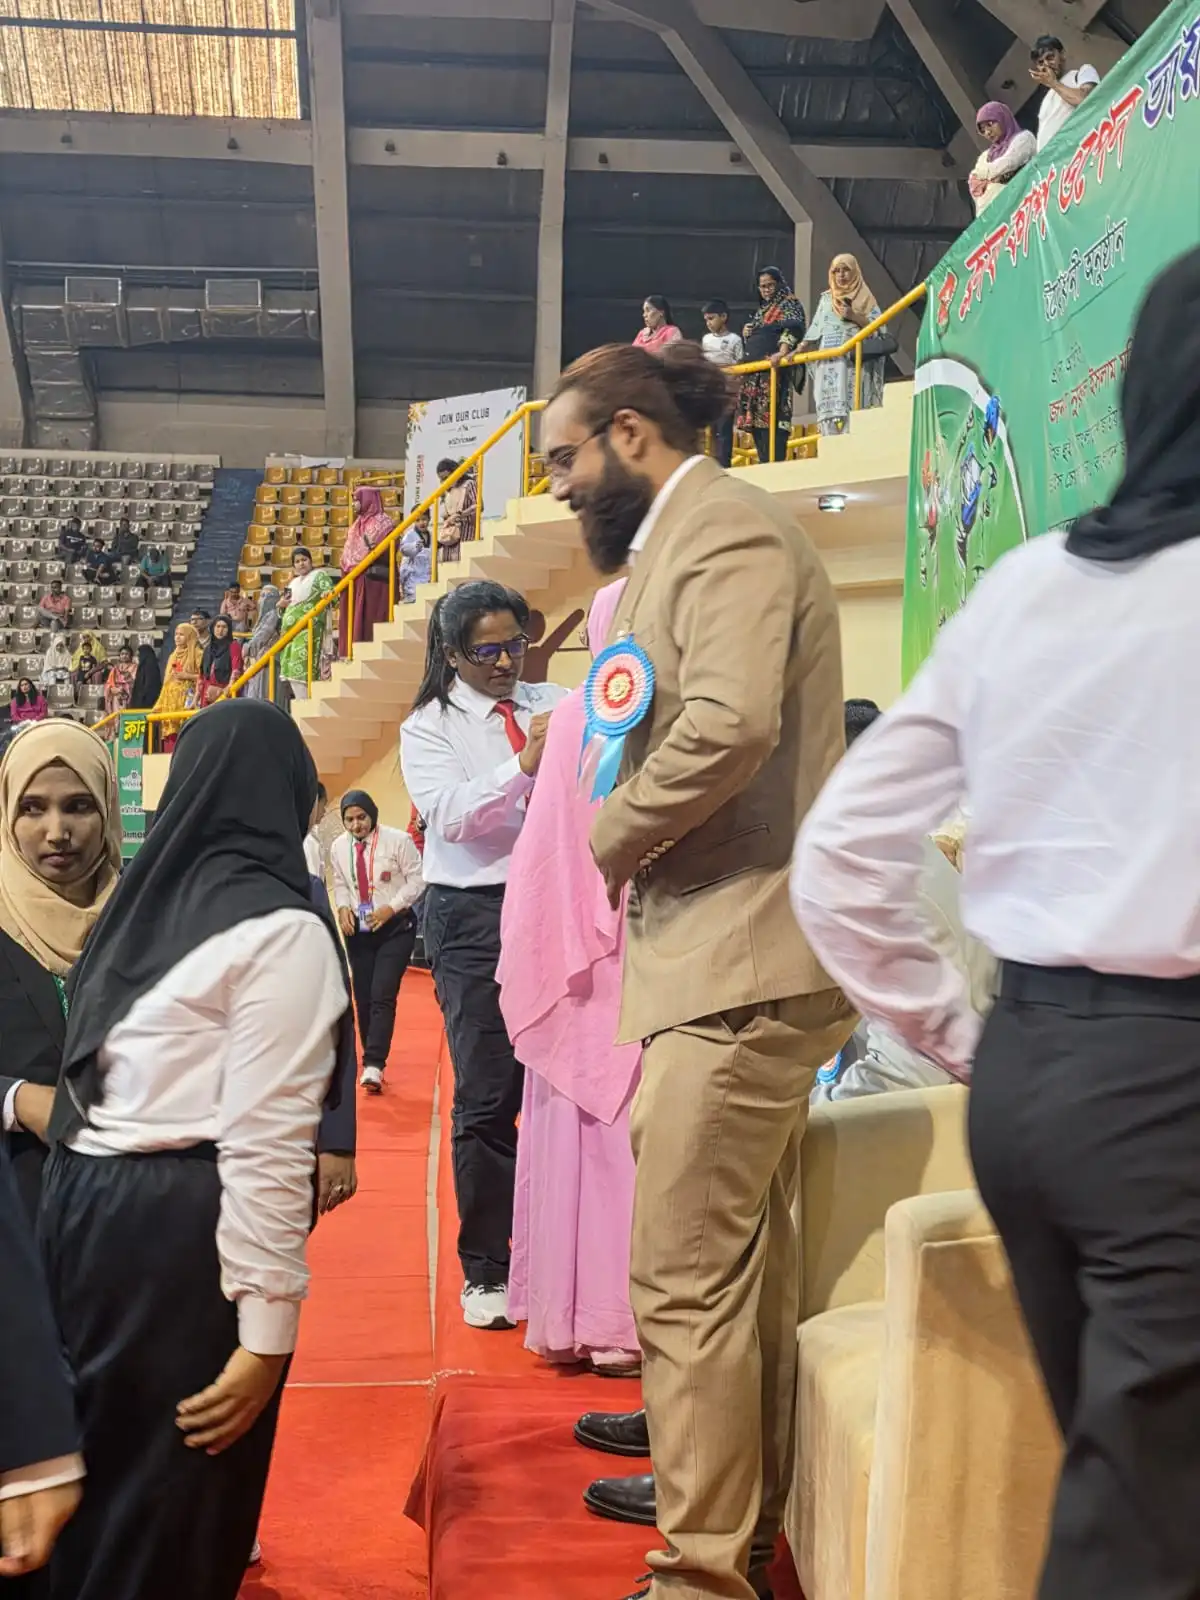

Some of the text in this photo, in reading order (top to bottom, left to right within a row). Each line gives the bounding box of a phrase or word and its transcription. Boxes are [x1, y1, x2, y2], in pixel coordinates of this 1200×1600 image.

[437, 407, 490, 426] JOIN OUR CLUB
